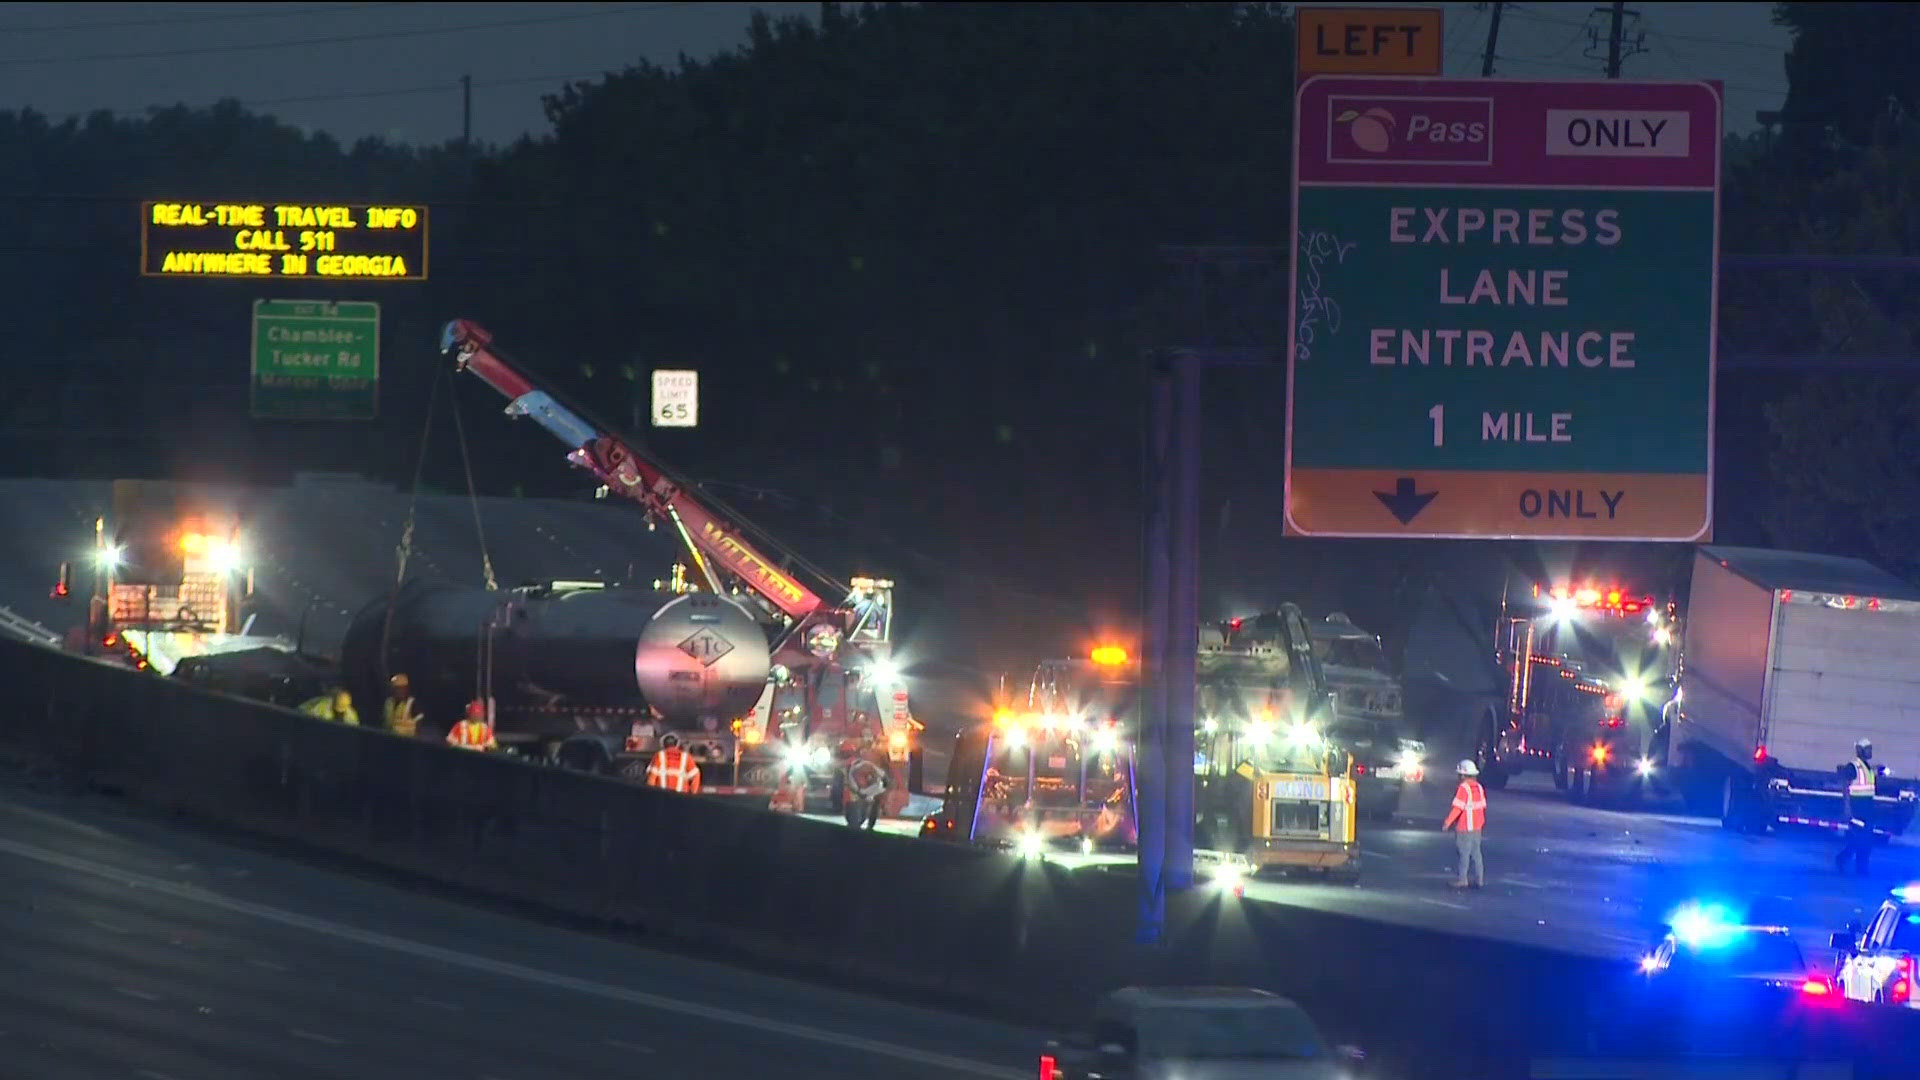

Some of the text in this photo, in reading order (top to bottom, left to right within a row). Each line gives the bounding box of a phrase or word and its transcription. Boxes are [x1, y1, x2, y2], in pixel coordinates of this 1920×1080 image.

[1317, 25, 1422, 57] LEFT
[1406, 114, 1486, 144] Pass
[1568, 119, 1667, 147] ONLY
[153, 203, 417, 229] REAL-TIME TRAVEL INFO
[1390, 207, 1622, 245] EXPRESS
[235, 229, 335, 251] CALL 511
[161, 252, 407, 276] ANYWHERE IN GEORGIA
[1440, 269, 1569, 306] LANE
[271, 350, 361, 368] Tucker Rd
[1370, 329, 1636, 368] ENTRANCE
[657, 376, 692, 387] SPEED
[660, 390, 689, 400] LIMIT
[661, 403, 688, 419] 65
[1429, 404, 1573, 447] 1 MILE
[1519, 489, 1624, 520] ONLY
